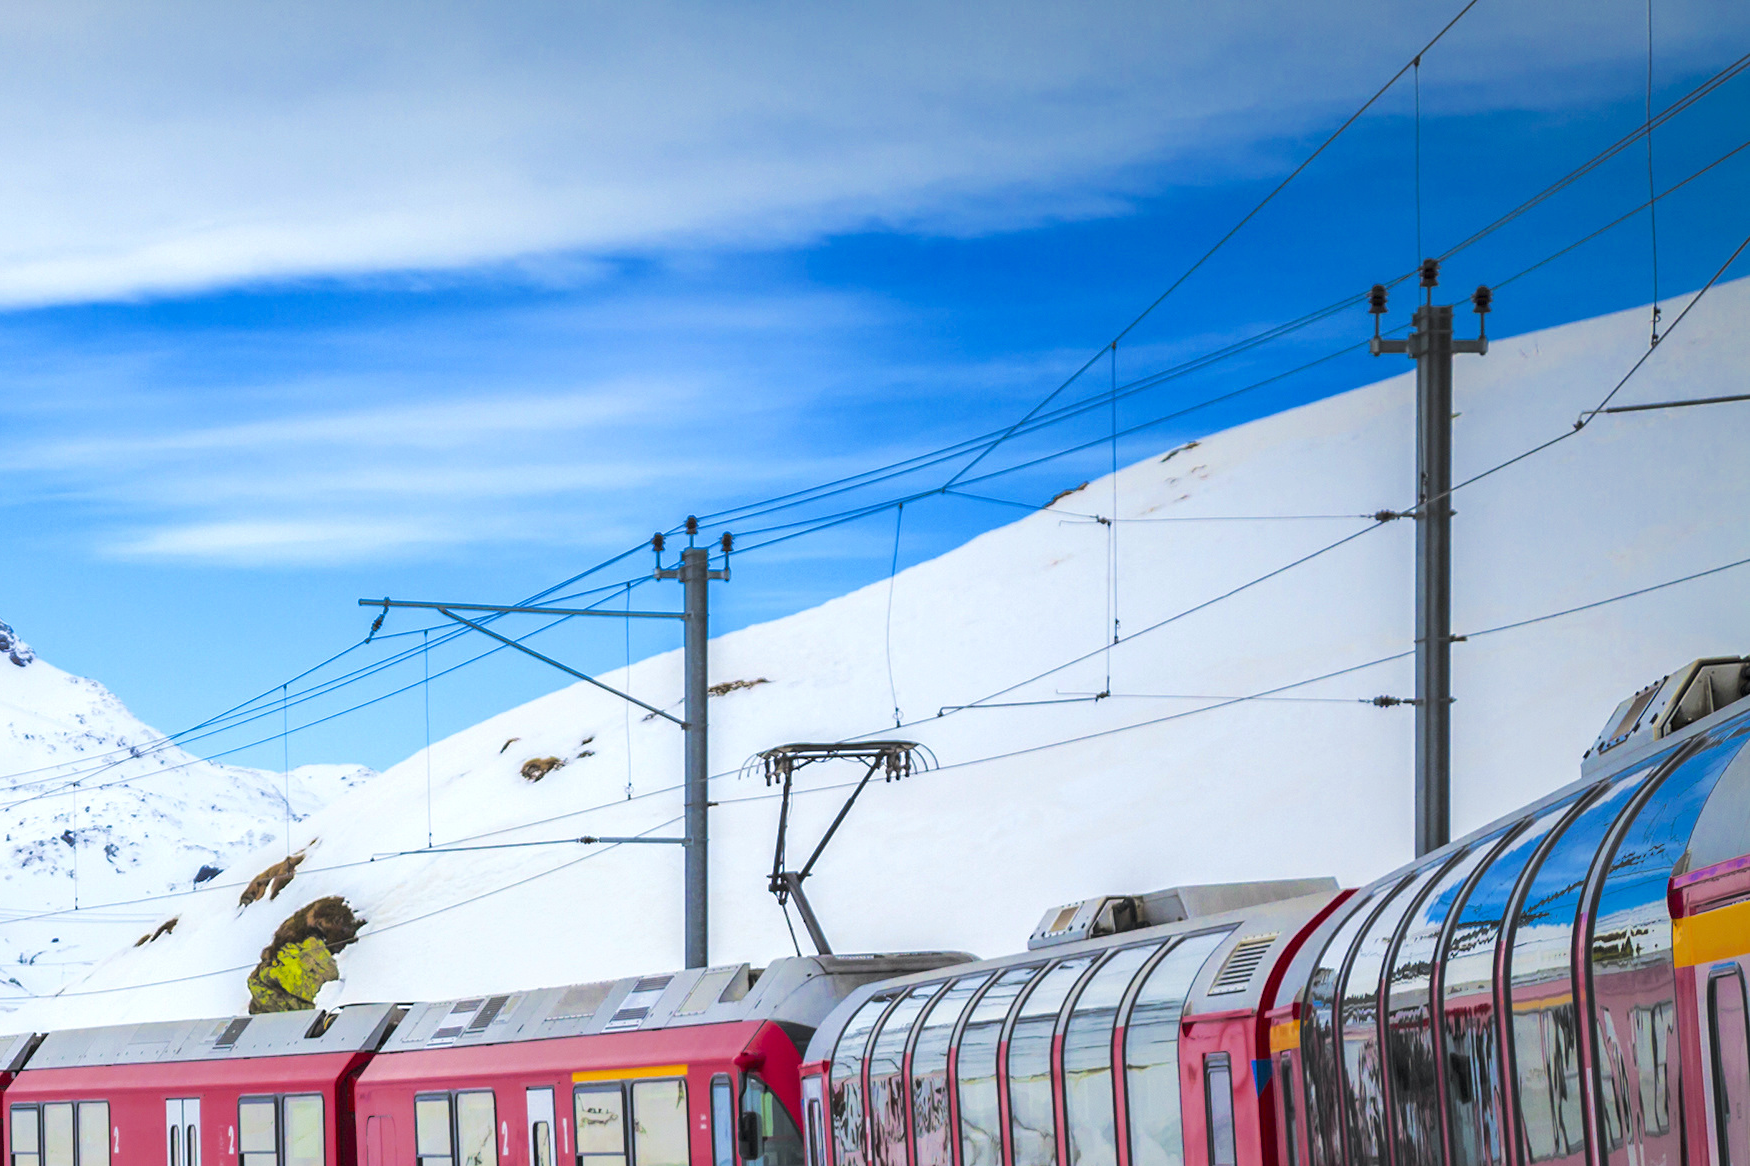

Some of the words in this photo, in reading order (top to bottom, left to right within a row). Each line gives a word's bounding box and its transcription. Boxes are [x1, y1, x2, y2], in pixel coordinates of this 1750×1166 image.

[113, 1126, 119, 1154] 2
[228, 1125, 235, 1155] 2
[501, 1120, 509, 1156] 2
[562, 1117, 568, 1154] 1
